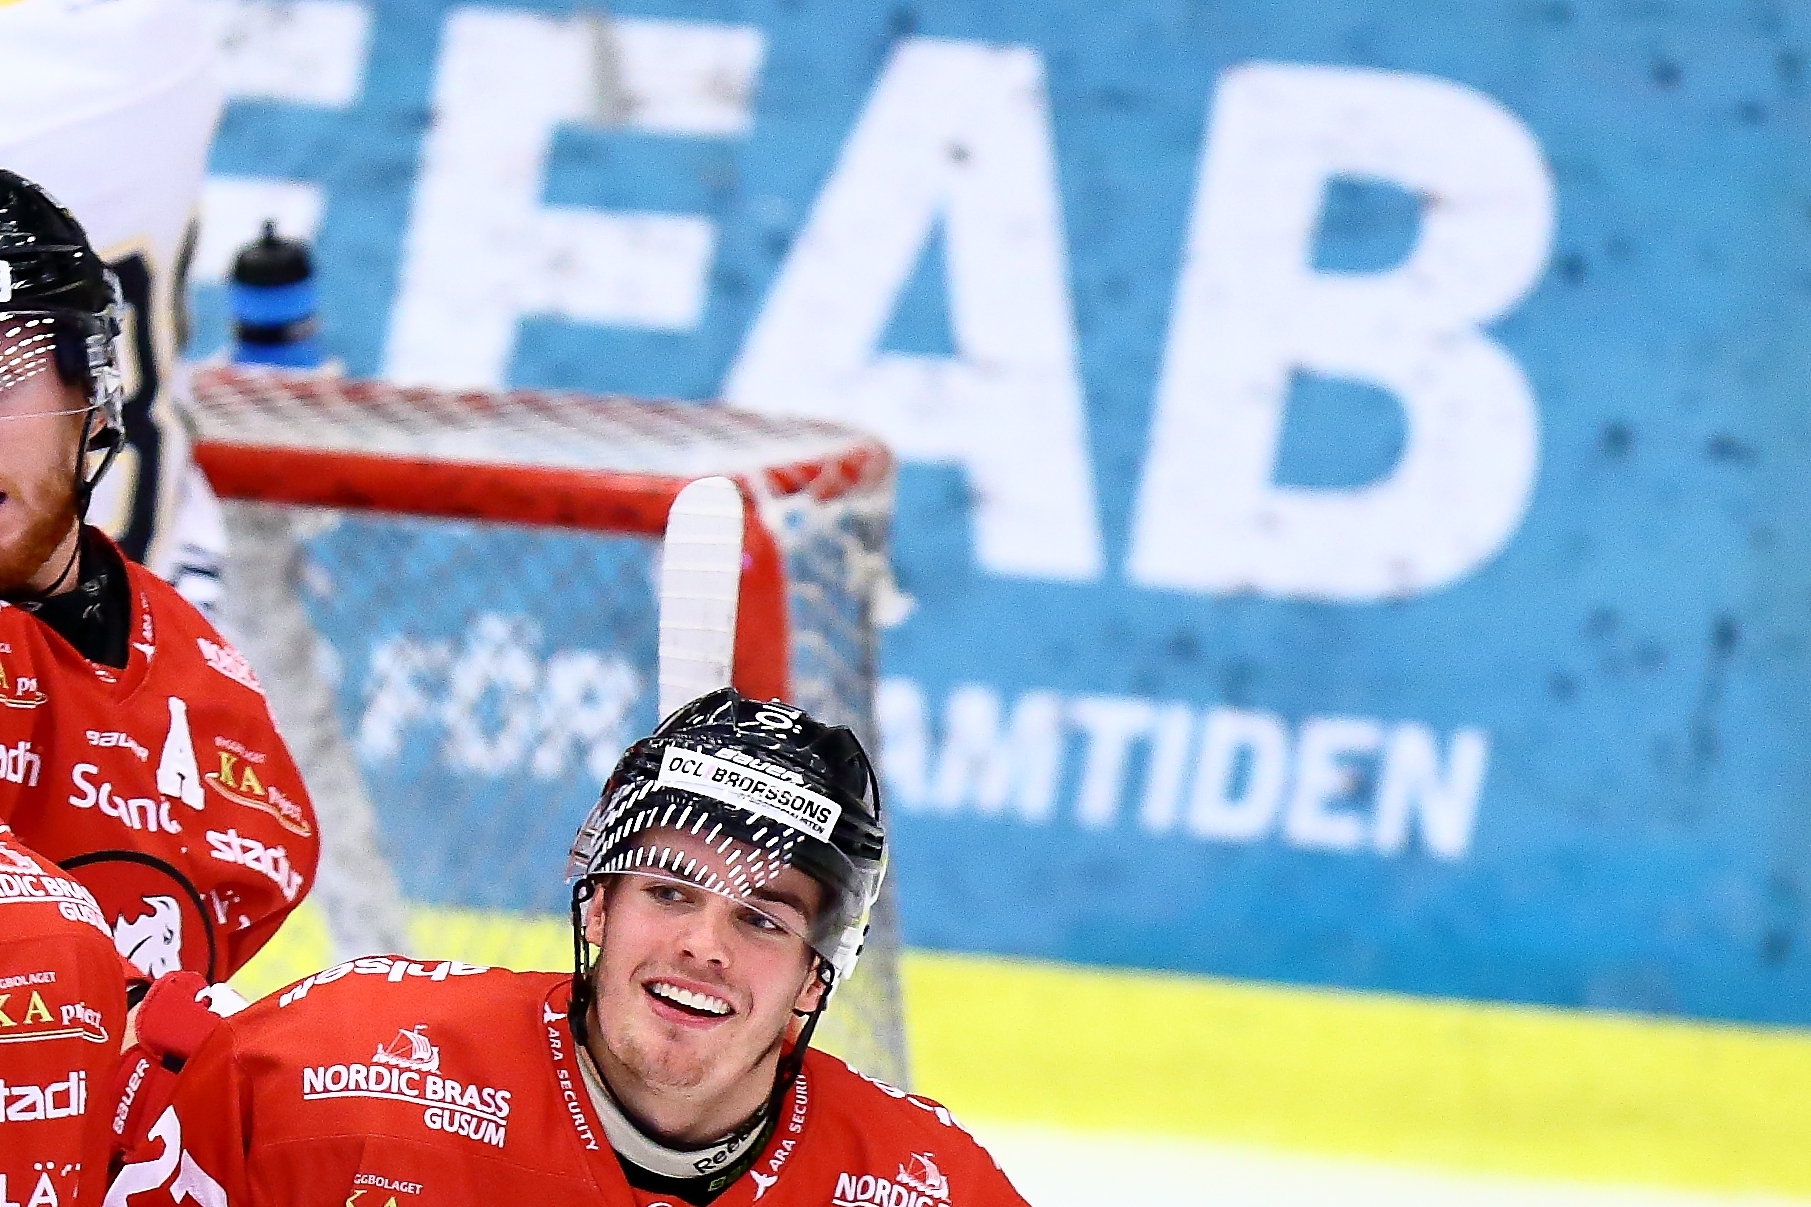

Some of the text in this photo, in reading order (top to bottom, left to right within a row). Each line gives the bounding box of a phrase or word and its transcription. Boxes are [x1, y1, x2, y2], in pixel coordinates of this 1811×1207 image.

[668, 756, 703, 778] OCL
[710, 766, 833, 825] BRORSSONS
[22, 990, 55, 1025] A
[303, 1066, 512, 1119] NORDIC BRASS
[547, 1026, 600, 1151] ARA SECURITY
[423, 1107, 507, 1149] GUSUM
[768, 1138, 797, 1172] ARA
